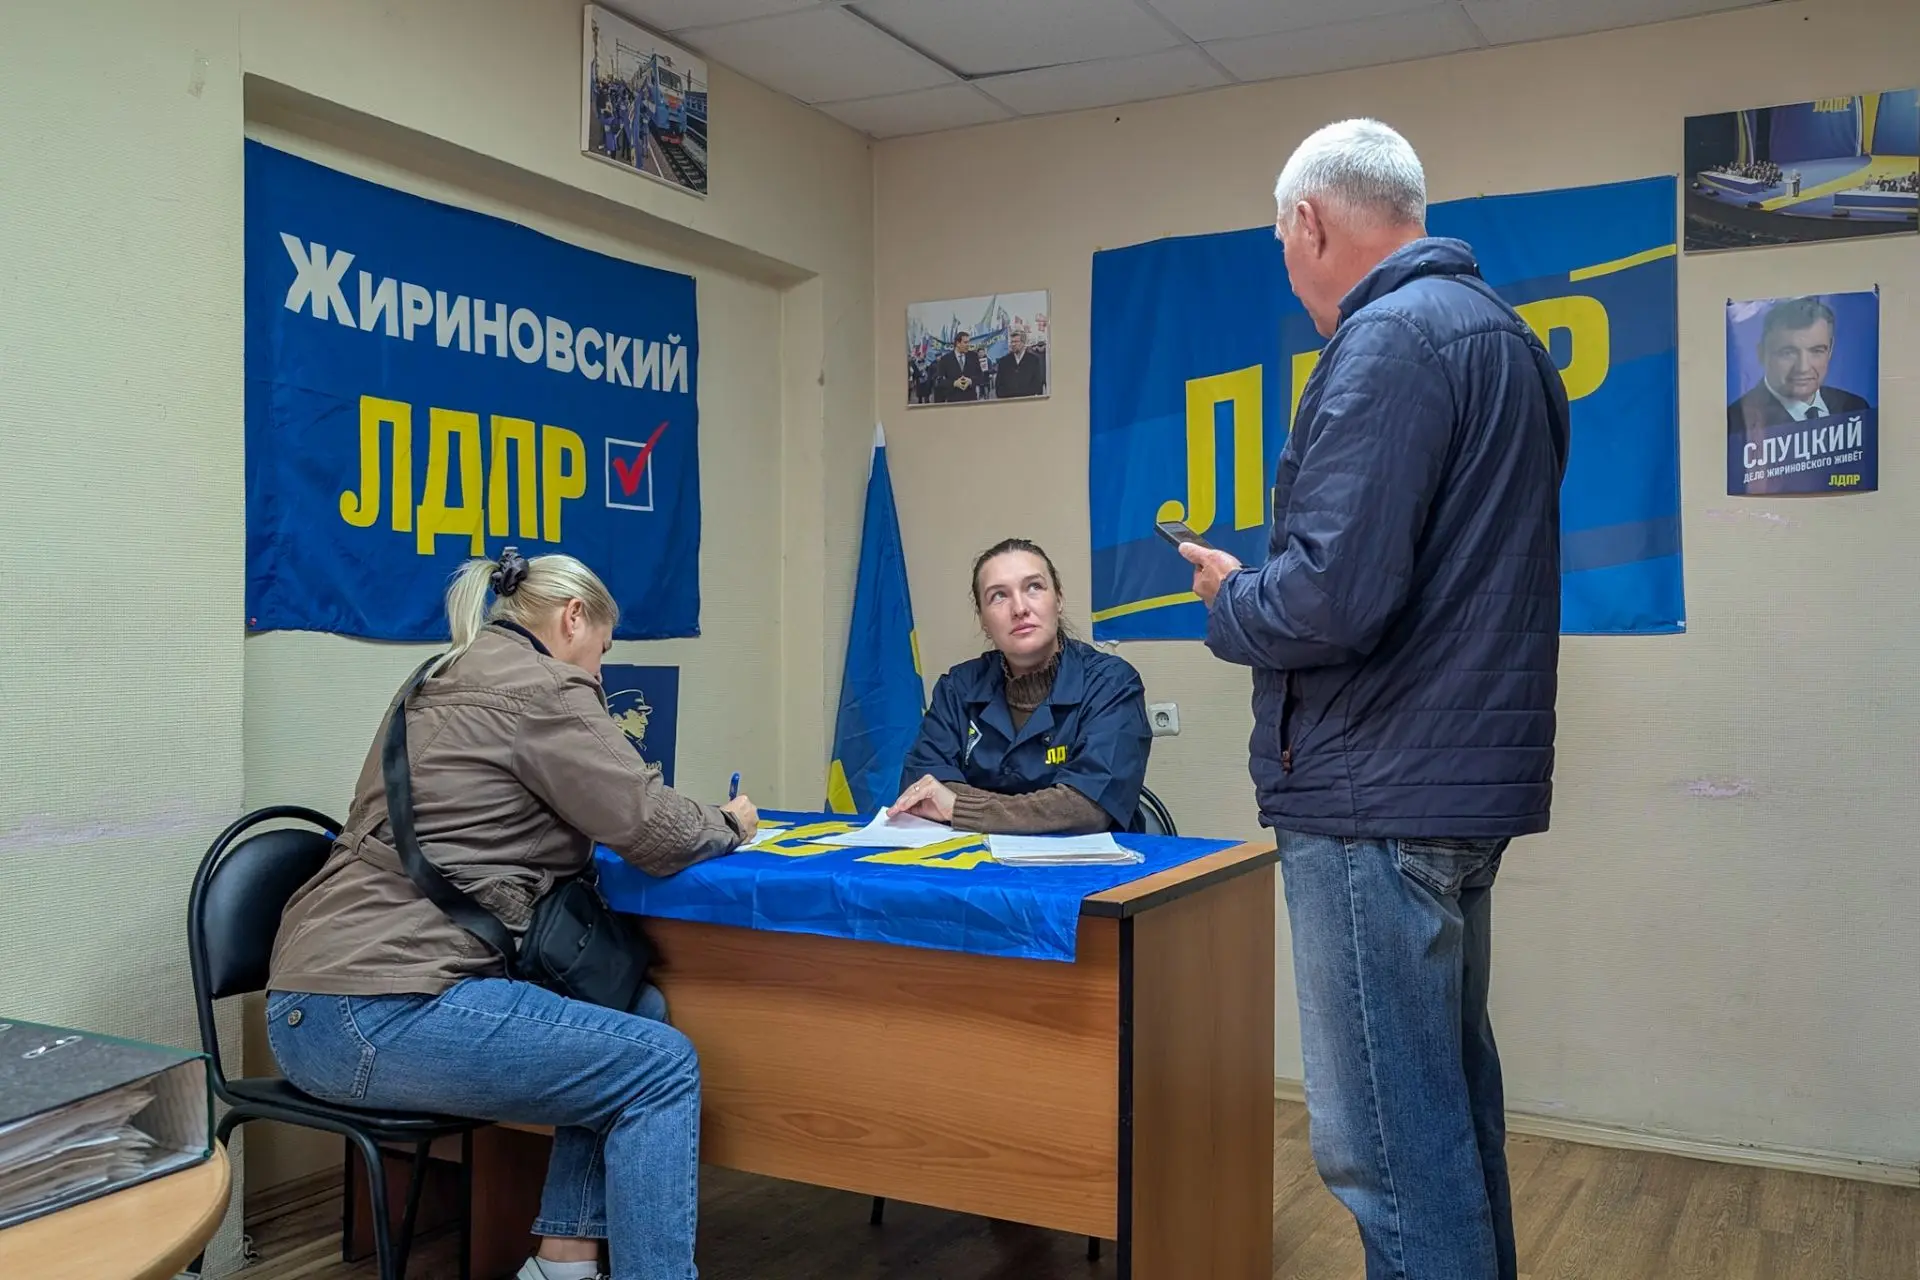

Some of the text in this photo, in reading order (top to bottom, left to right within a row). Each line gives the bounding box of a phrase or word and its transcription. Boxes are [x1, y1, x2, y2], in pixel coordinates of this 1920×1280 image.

[279, 231, 689, 394] ЖИРИНОВСКИЙ
[1156, 295, 1610, 535] ЛР
[1743, 415, 1863, 469] СЛУЦКИЙ
[1743, 450, 1863, 484] ДЕЛО ЖИРИНОВСКОГО ЖИВЁТ
[339, 394, 587, 556] ЛДПР
[1828, 473, 1861, 487] ЛДПР
